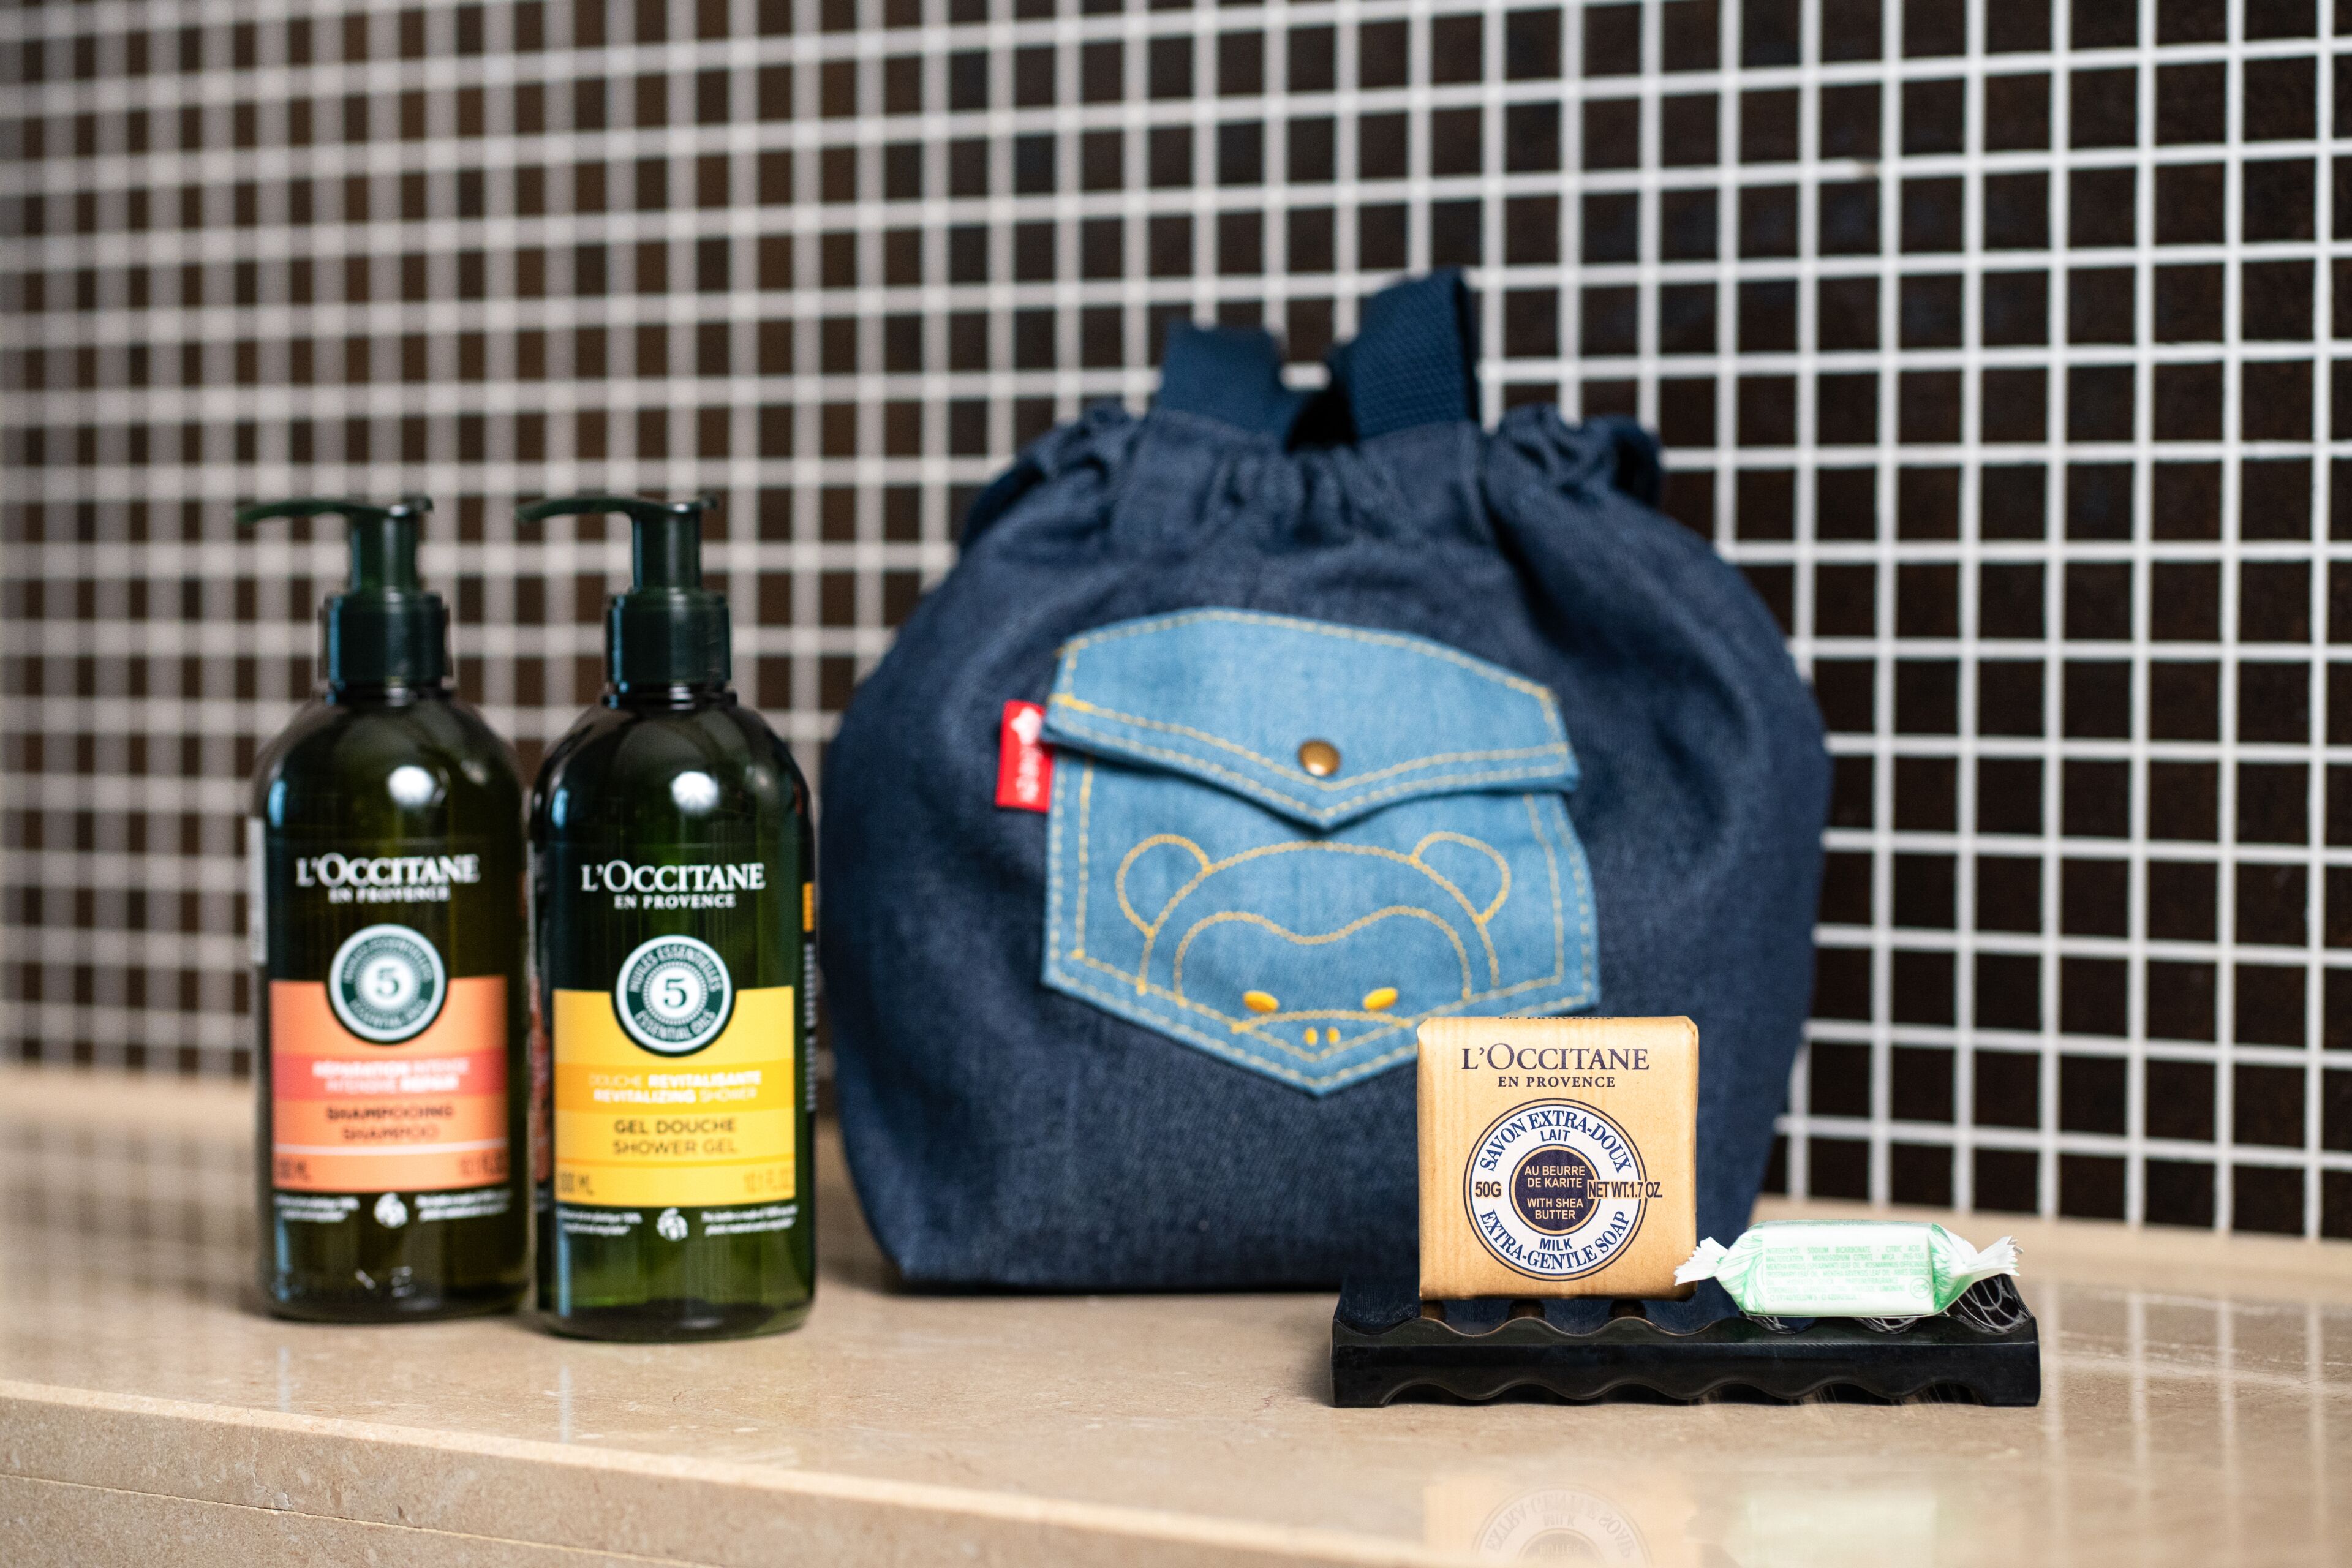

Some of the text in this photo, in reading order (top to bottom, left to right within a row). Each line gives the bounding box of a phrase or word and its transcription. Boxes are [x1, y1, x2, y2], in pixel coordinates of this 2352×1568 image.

[581, 859, 766, 892] L'OCCITANE
[328, 886, 451, 903] EN PROVENCE
[613, 894, 736, 910] EN PROVENCE
[630, 946, 722, 993] HUILES ESSENTIELLES
[375, 967, 399, 997] 5
[663, 978, 687, 1009] 5
[635, 1009, 692, 1039] ESSENTIAL
[1461, 1043, 1649, 1071] L'OCCITANE
[648, 1070, 761, 1088] REVITALISANTE
[1498, 1077, 1615, 1087] EN PROVENCE
[593, 1088, 696, 1104] REVITALIZING
[327, 1106, 453, 1120] SHAMPOOING
[343, 1125, 439, 1140] SHAMPOO
[614, 1118, 736, 1135] GEL DOUCHE
[1480, 1110, 1632, 1173] SAVON EXTRA-DOUX
[1540, 1129, 1570, 1142] LAIT
[613, 1139, 737, 1155] SHOWER GEL
[1525, 1166, 1585, 1176] AU BEURRE
[1475, 1181, 1501, 1198] 50G
[1528, 1178, 1582, 1188] DE KARITE
[1588, 1182, 1610, 1198] NET
[1646, 1182, 1662, 1198] OZ.
[1527, 1198, 1583, 1208] WITH SHEA
[1535, 1210, 1575, 1219] BUTTER
[1480, 1209, 1630, 1269] EXTRA-GENTLE SOAP
[1540, 1238, 1573, 1251] MILK
